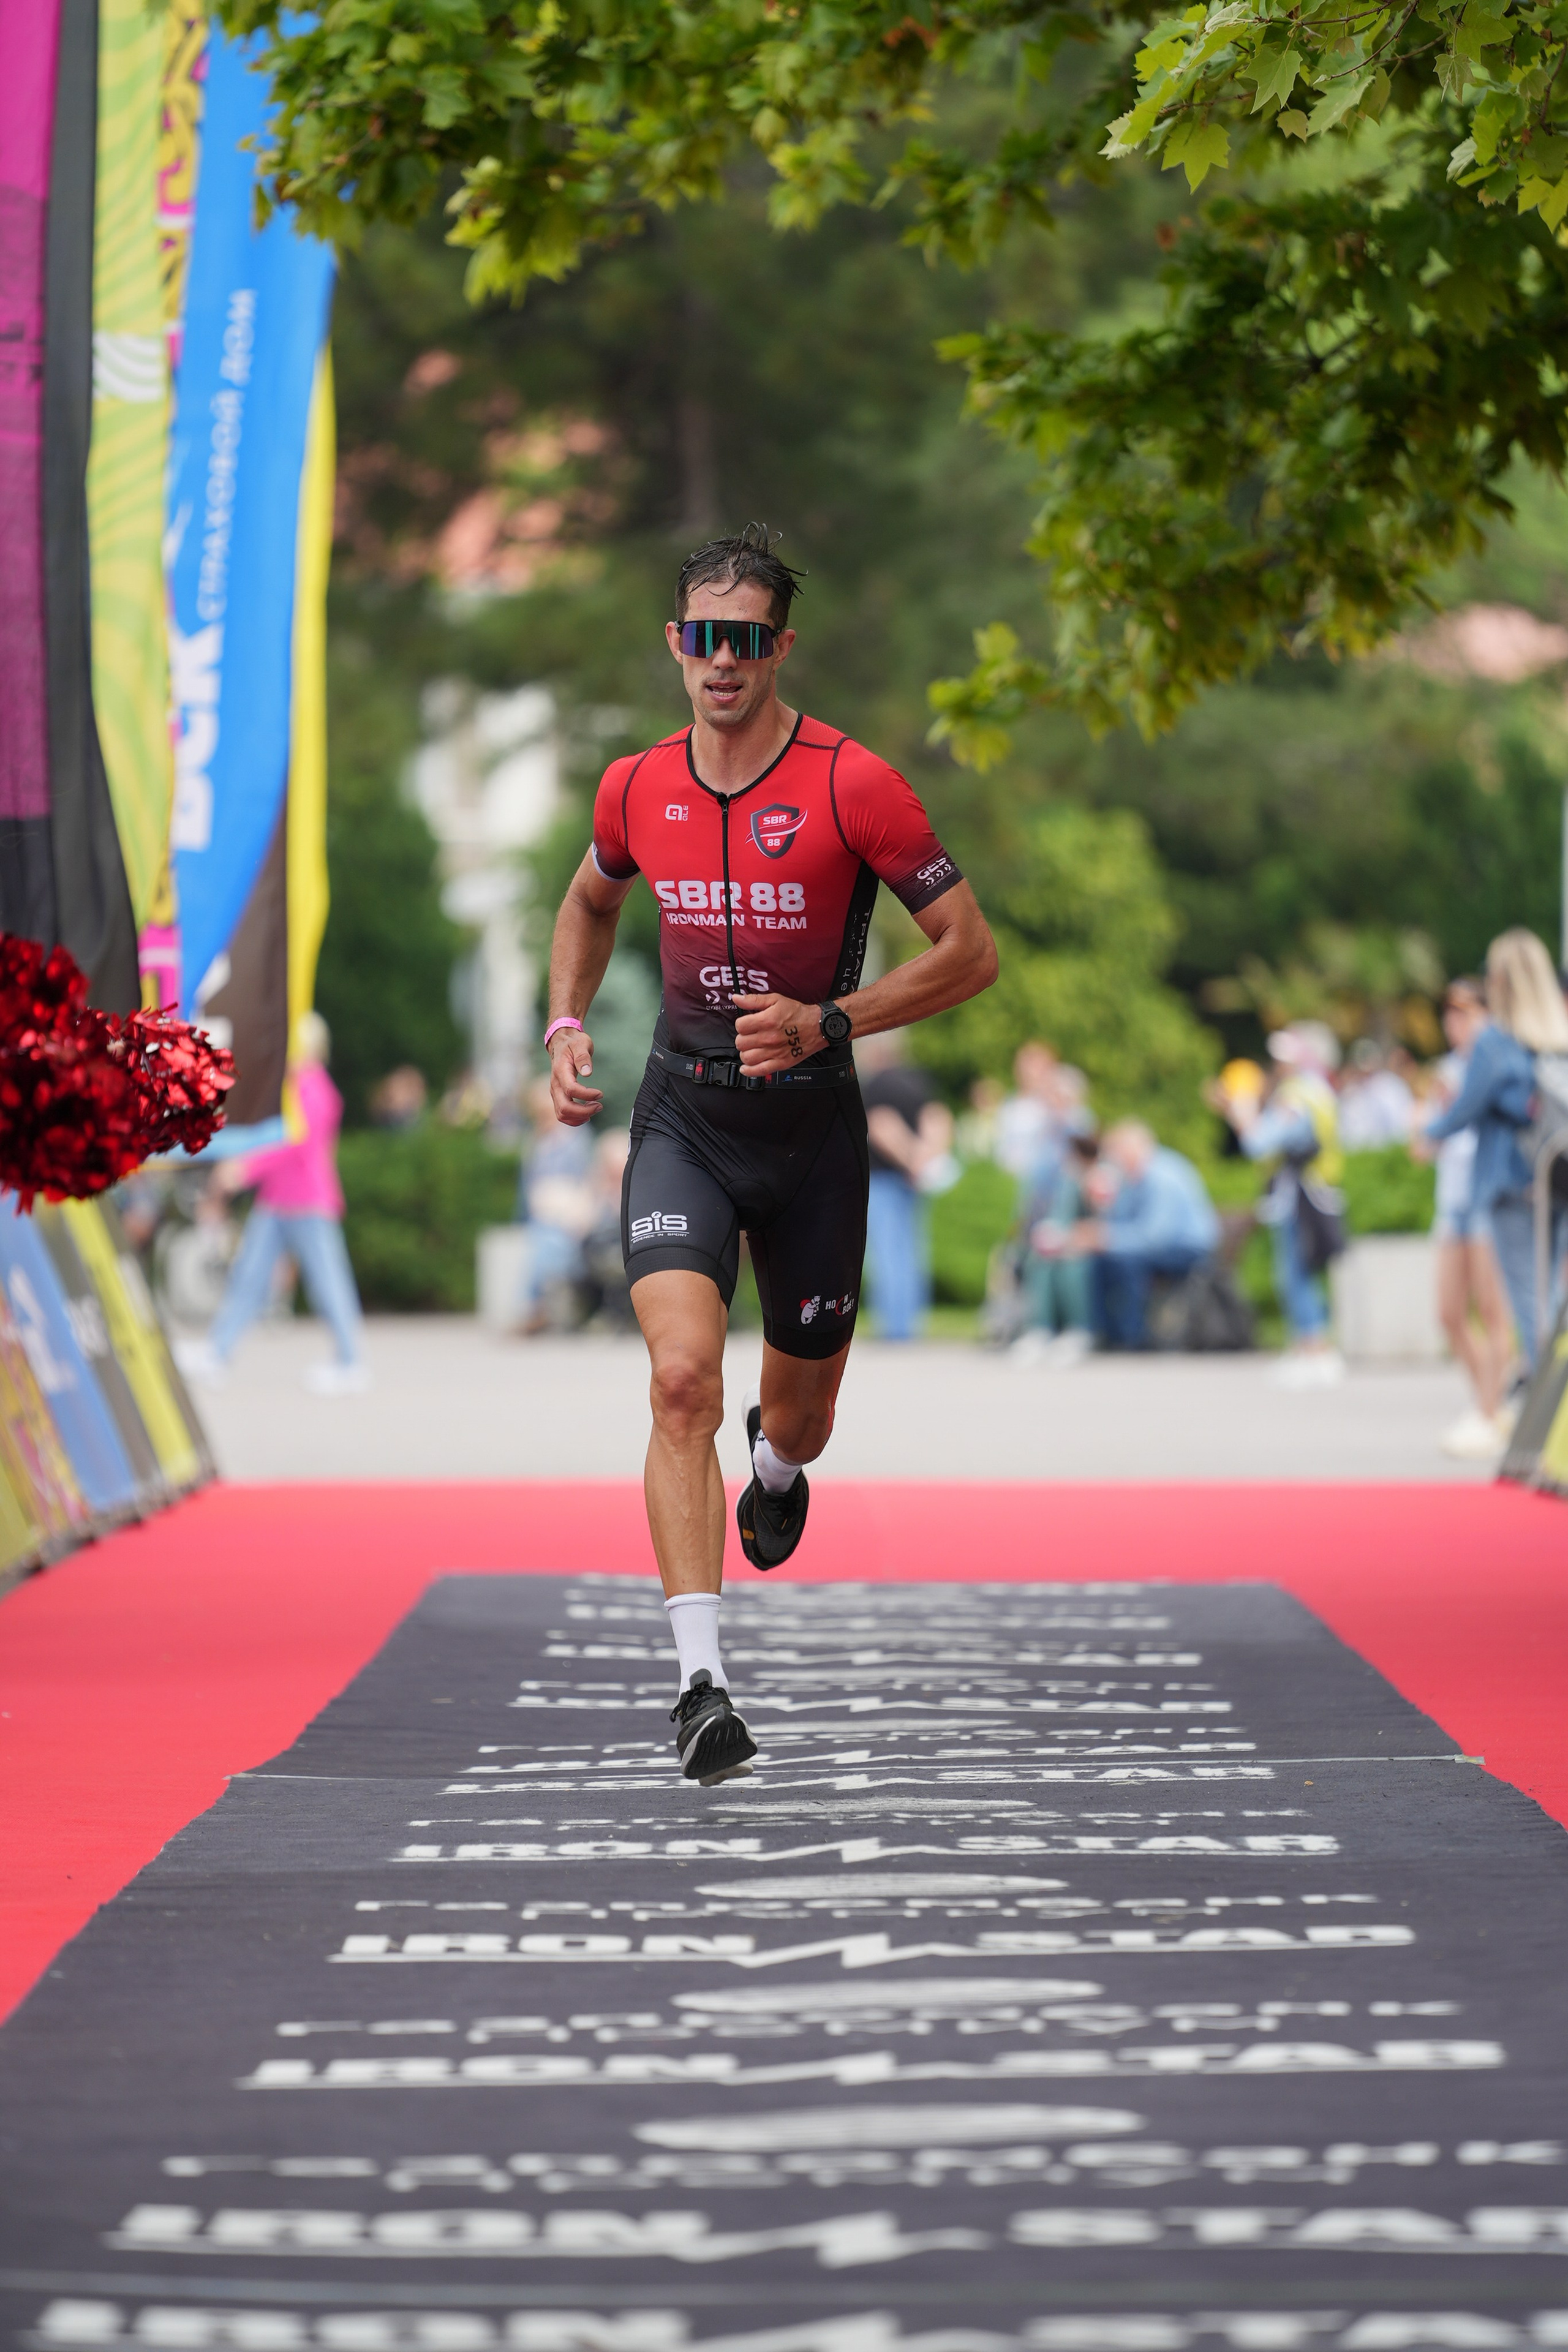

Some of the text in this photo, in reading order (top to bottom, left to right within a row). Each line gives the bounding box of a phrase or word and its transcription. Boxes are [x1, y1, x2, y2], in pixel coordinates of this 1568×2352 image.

[763, 815, 787, 825] SBR
[917, 858, 946, 880] GES
[655, 880, 805, 912] SBR 88
[666, 913, 807, 930] IRONMAN TEAM
[699, 966, 769, 992] GES
[785, 1026, 803, 1057] 358
[633, 1234, 655, 1243] SCIENCE
[936, 1767, 1275, 1781] STAR
[401, 1834, 1340, 1856] IRON STAR
[342, 1924, 1413, 1954] IRON STAR
[252, 2053, 737, 2082] IRON
[126, 2203, 709, 2247] IRON
